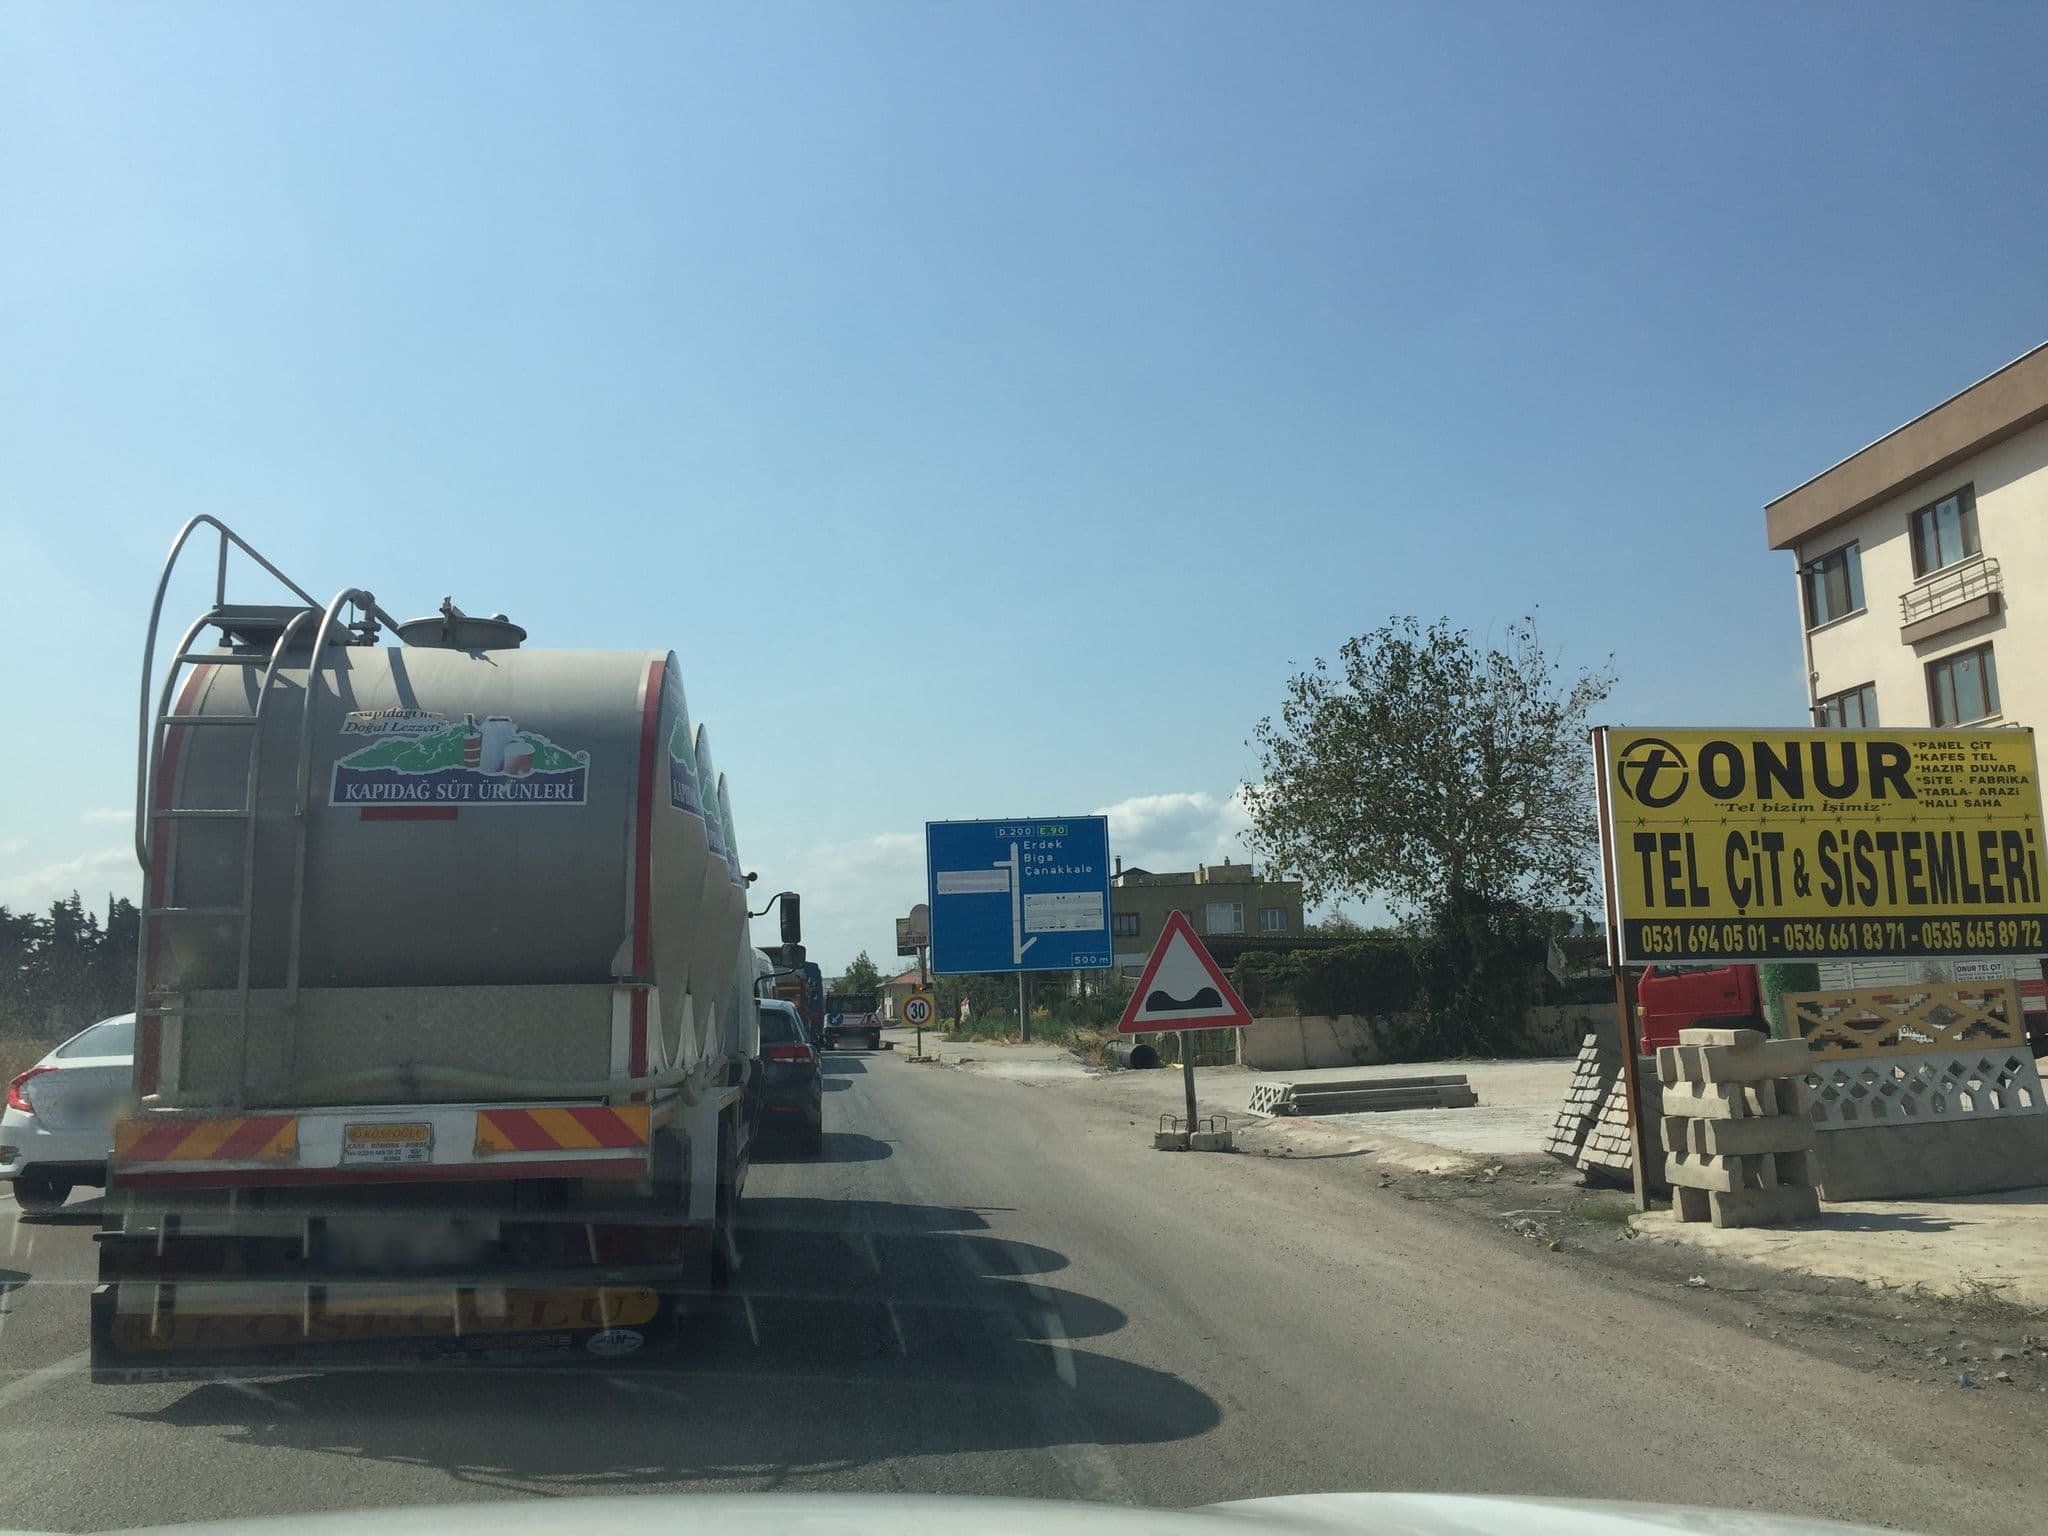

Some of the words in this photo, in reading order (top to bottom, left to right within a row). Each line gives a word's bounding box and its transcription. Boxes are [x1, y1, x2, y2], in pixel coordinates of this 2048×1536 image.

[1971, 753, 1998, 761] TEL
[1698, 740, 1918, 800] ONUR
[1970, 764, 2017, 773] DUVAR
[345, 778, 431, 800] KAPIDAĞ
[436, 778, 473, 799] SÜT
[478, 778, 574, 799] ÜRÜNLERİ
[1762, 802, 1815, 813] bizim
[1023, 840, 1063, 850] Erdek
[1024, 853, 1054, 864] Biga
[1024, 864, 1093, 876] Çanakkale
[1633, 832, 1711, 907] TEL
[1793, 847, 1812, 898] &
[1641, 924, 1683, 952] 0531
[1688, 924, 1720, 952] 694
[1722, 924, 1744, 952] 05
[1747, 924, 1767, 951] 01
[1783, 923, 1825, 951] 0536
[1829, 923, 1857, 950] 661
[1863, 922, 1884, 950] 83
[1886, 922, 1906, 950] 71
[1922, 921, 1962, 949] 0535
[1966, 921, 1995, 948] 665
[1999, 920, 2018, 948] 89
[2020, 920, 2043, 948] 72
[1074, 956, 1096, 964] 500
[910, 1003, 925, 1020] 30
